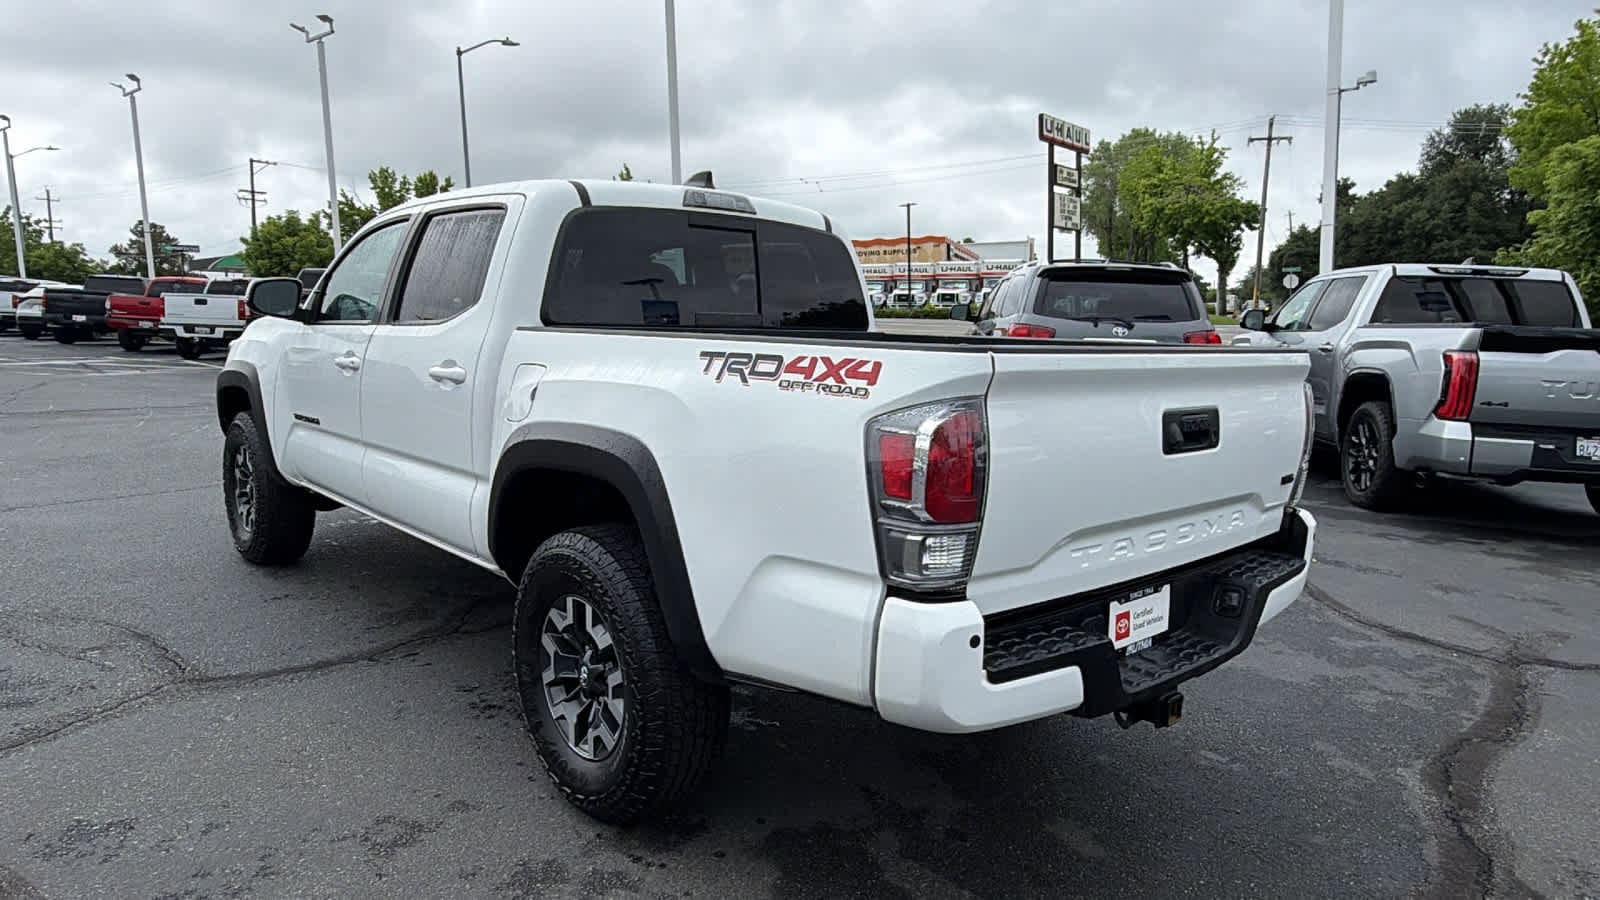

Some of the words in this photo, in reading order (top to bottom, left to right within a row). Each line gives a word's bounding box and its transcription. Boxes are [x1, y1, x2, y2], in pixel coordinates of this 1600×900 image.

[1045, 118, 1090, 147] U-HAUL
[940, 265, 975, 273] U-HAUL
[700, 351, 784, 386] TRD
[778, 379, 815, 393] OFF
[815, 383, 870, 400] ROAD
[1070, 509, 1245, 568] TACOMA
[1133, 607, 1153, 620] Certified
[1133, 621, 1146, 631] Used
